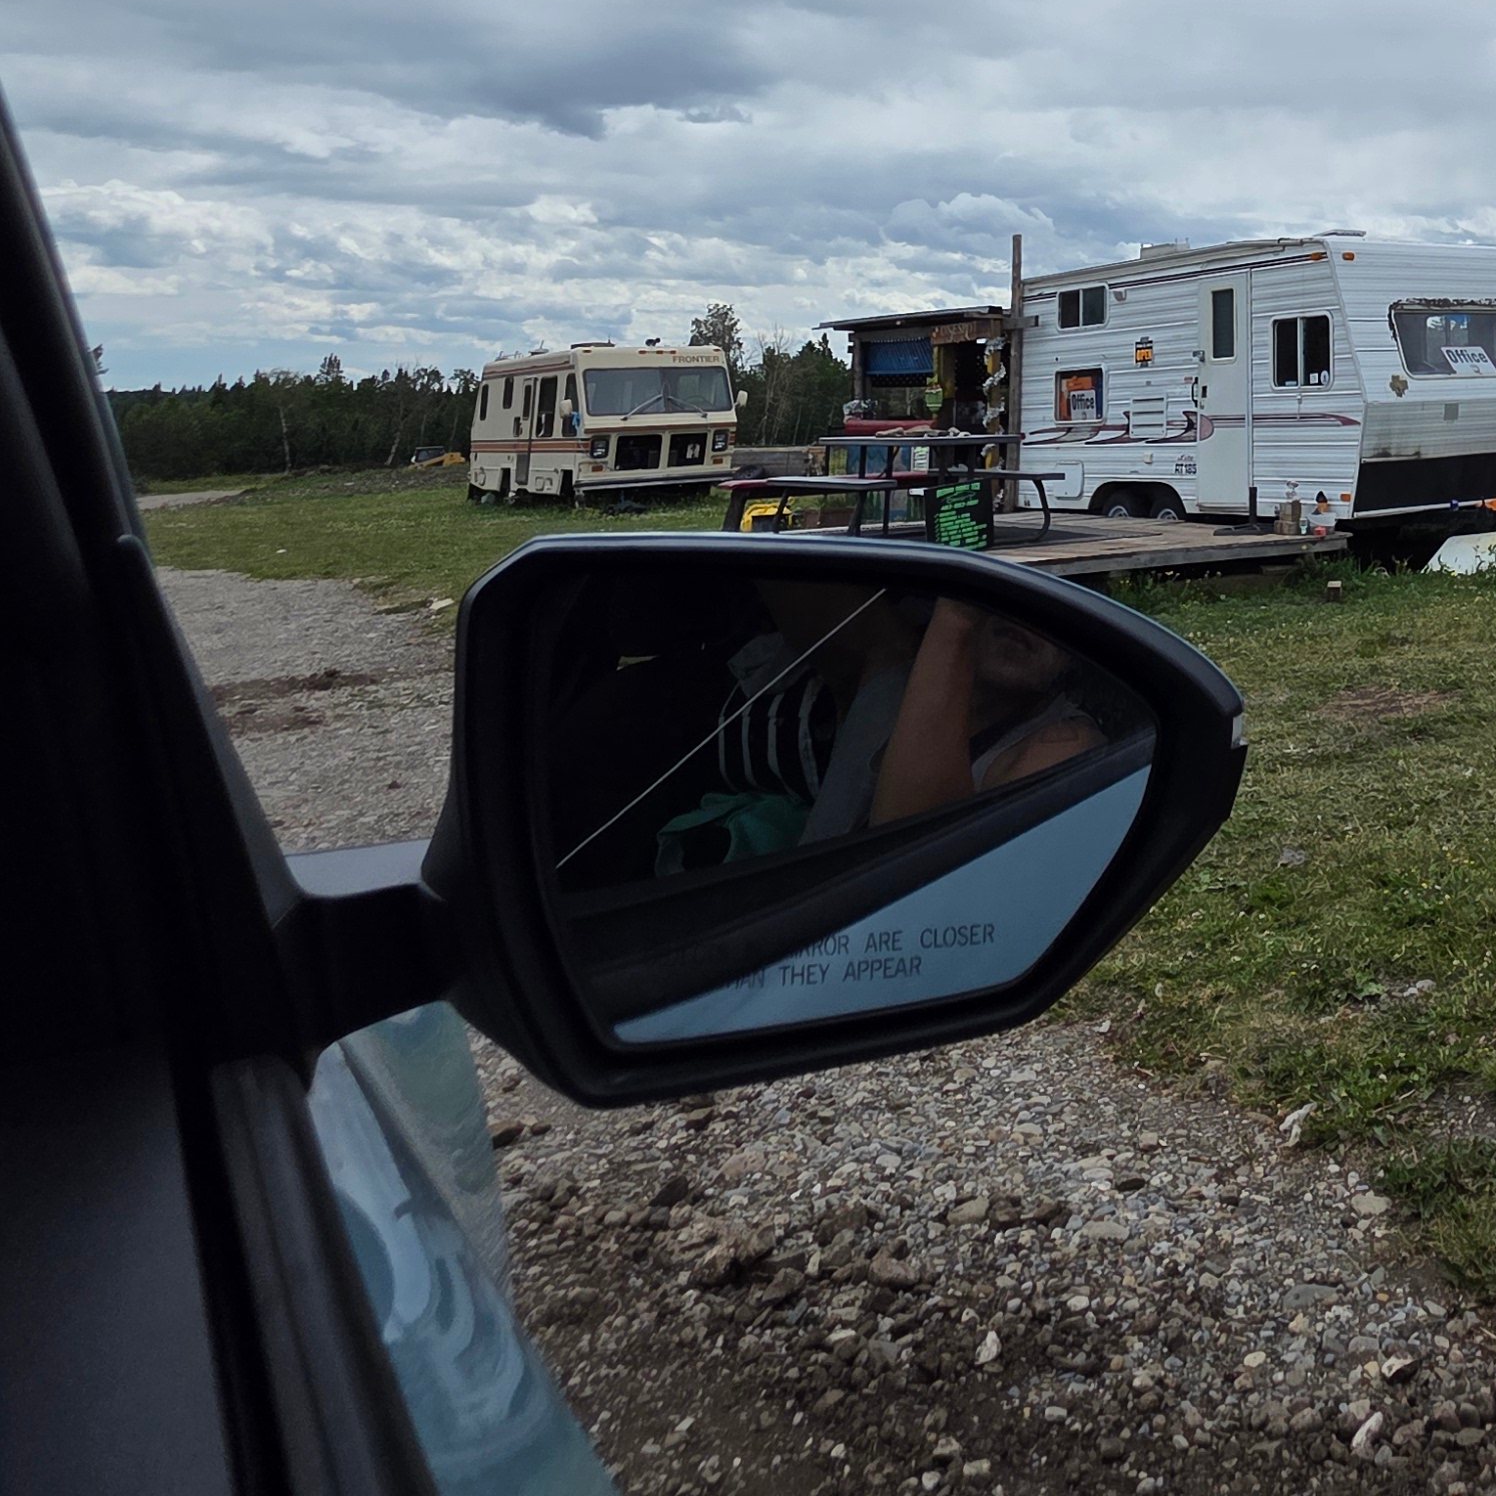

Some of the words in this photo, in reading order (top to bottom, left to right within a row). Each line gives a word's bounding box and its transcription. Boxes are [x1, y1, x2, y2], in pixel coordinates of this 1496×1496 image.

[672, 355, 720, 364] FRONTIER
[1446, 349, 1488, 364] Office
[1072, 393, 1095, 410] Office
[787, 933, 850, 959] ROR
[864, 930, 902, 953] ARE
[919, 924, 996, 949] CLOSER
[779, 962, 830, 987] THEY
[842, 955, 922, 983] APPEAR
